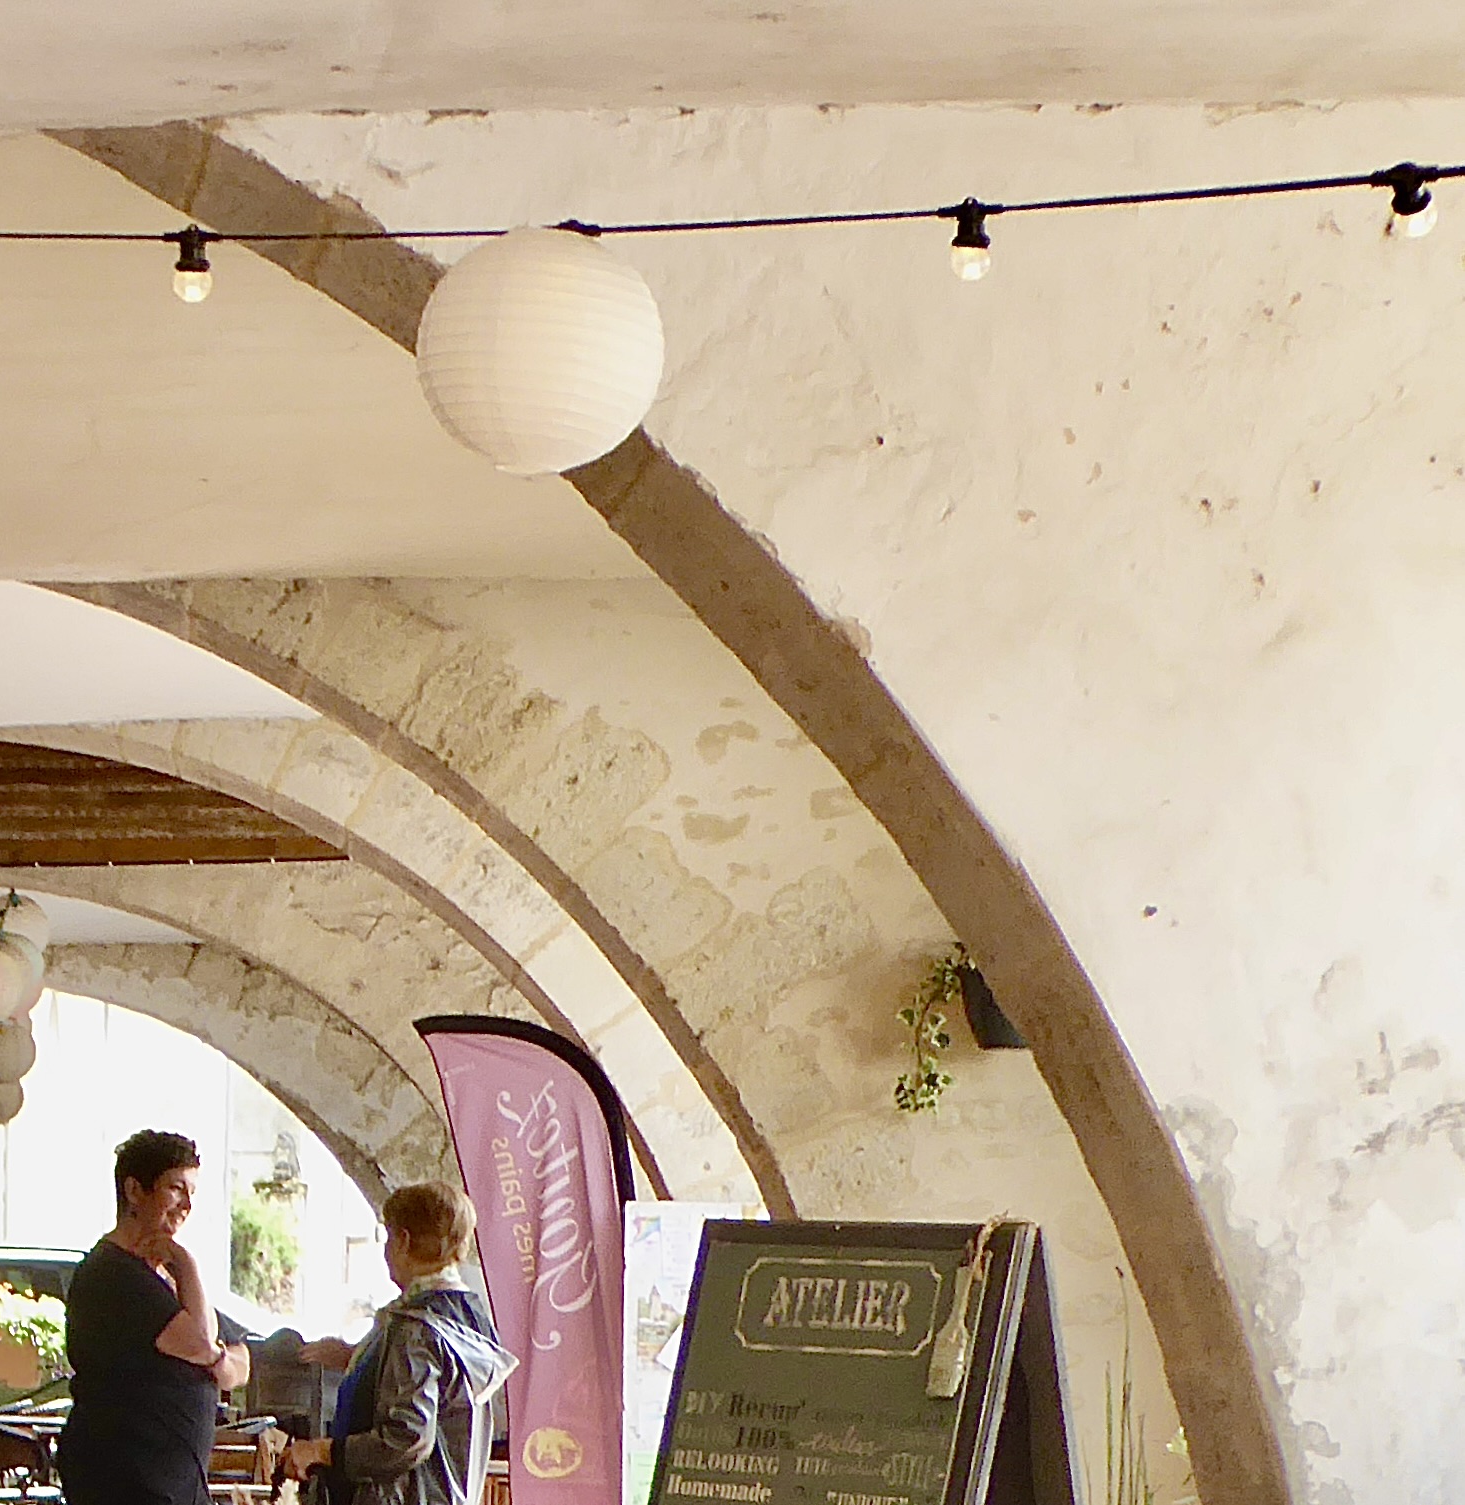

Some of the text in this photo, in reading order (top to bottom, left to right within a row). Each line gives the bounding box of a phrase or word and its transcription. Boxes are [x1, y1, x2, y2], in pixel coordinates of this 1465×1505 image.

[762, 1276, 912, 1337] ATELIER
[672, 1449, 780, 1477] RELOOKING
[666, 1473, 773, 1504] Homemade
